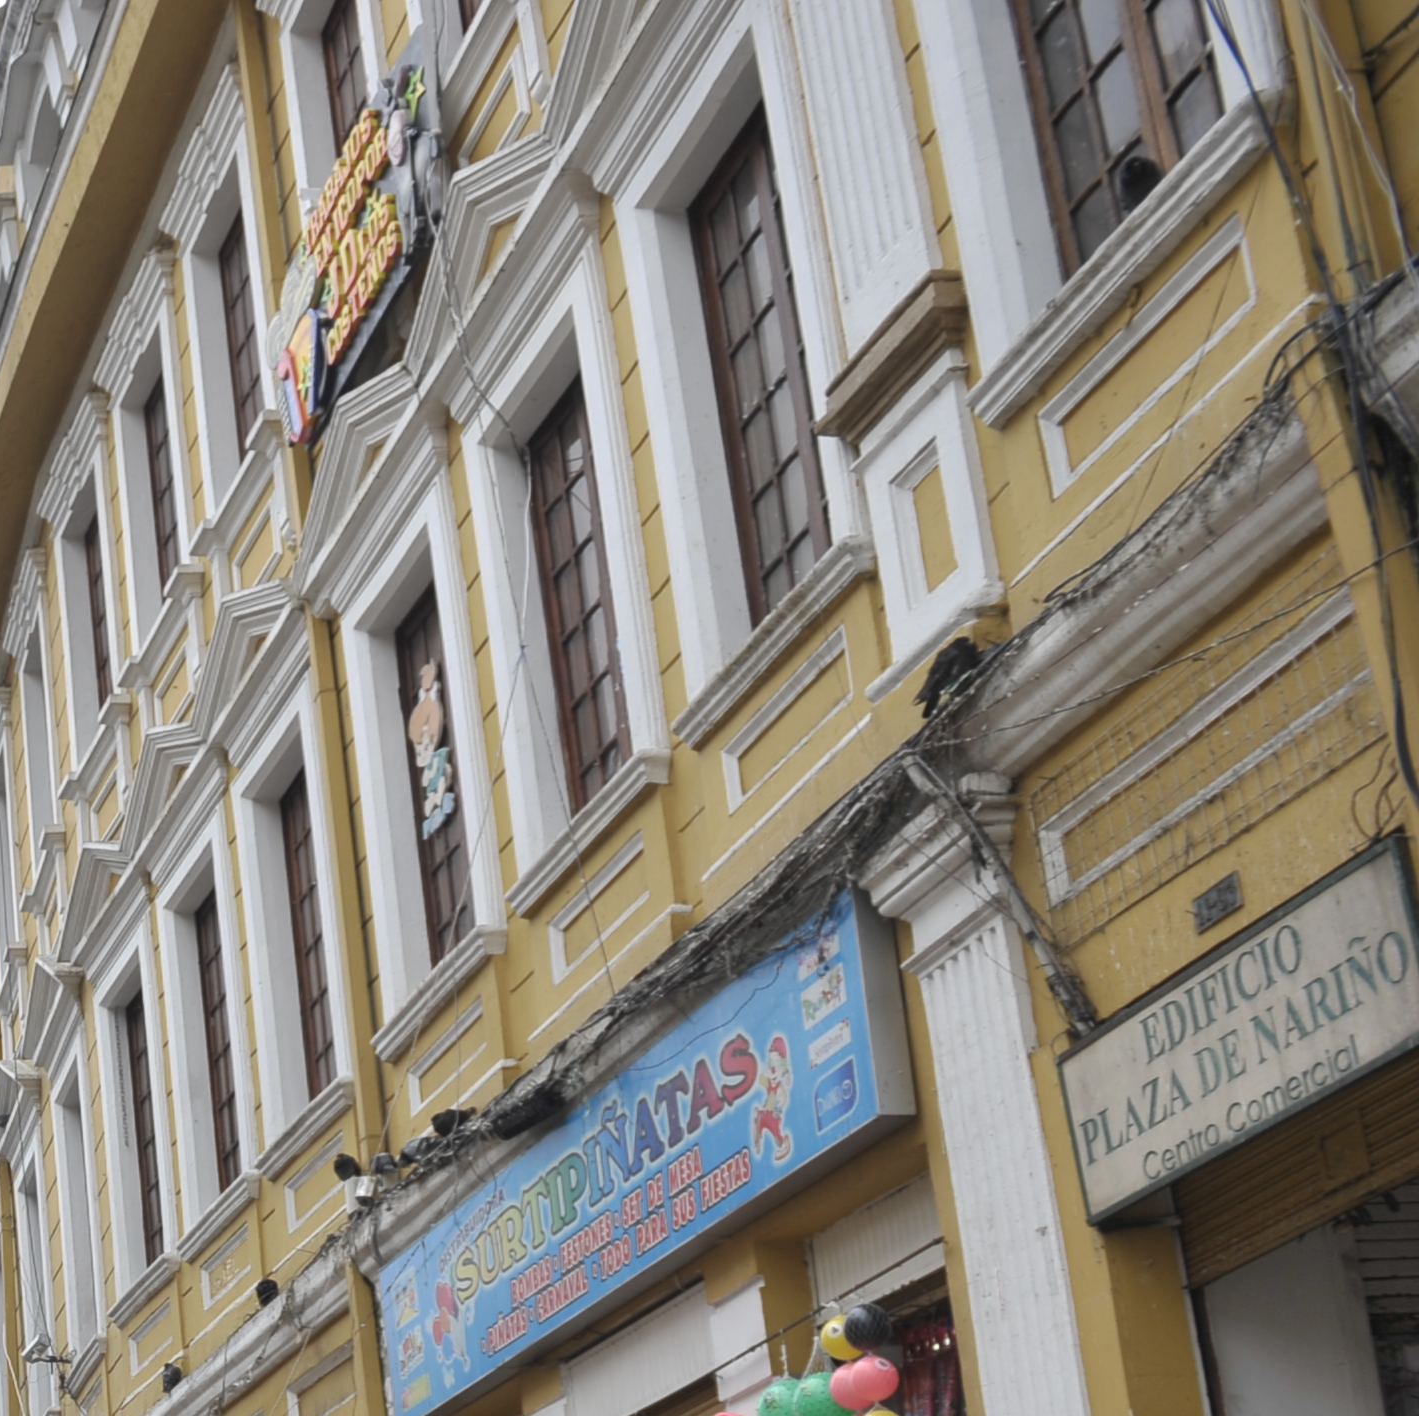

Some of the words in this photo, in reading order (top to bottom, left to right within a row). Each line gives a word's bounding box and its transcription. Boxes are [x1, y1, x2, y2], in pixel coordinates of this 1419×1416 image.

[306, 108, 373, 256] TRABAJOS
[314, 222, 333, 279] EN
[332, 127, 387, 241] ICOPOR
[327, 220, 401, 366] COSTEÑOS
[1079, 1068, 1193, 1167] PLAZA
[1193, 1029, 1247, 1098] DE
[1250, 930, 1409, 1065] NARIÑO
[1139, 924, 1303, 1065] EDIFICIO
[454, 1032, 759, 1305] SURTIPIÑATAS
[1142, 1121, 1221, 1182] Centro
[1226, 1033, 1359, 1134] Comercial
[487, 1304, 529, 1356] PIÑATAS
[535, 1264, 589, 1323] CARNAVAL
[599, 1233, 632, 1283] TODO
[636, 1208, 669, 1258] PARA
[672, 1187, 696, 1231] SUS
[700, 1146, 751, 1214] FIESTAS
[511, 1254, 553, 1307] BOMBAS
[621, 1188, 642, 1228] SET
[647, 1170, 663, 1212] DE
[668, 1143, 703, 1197] MESA
